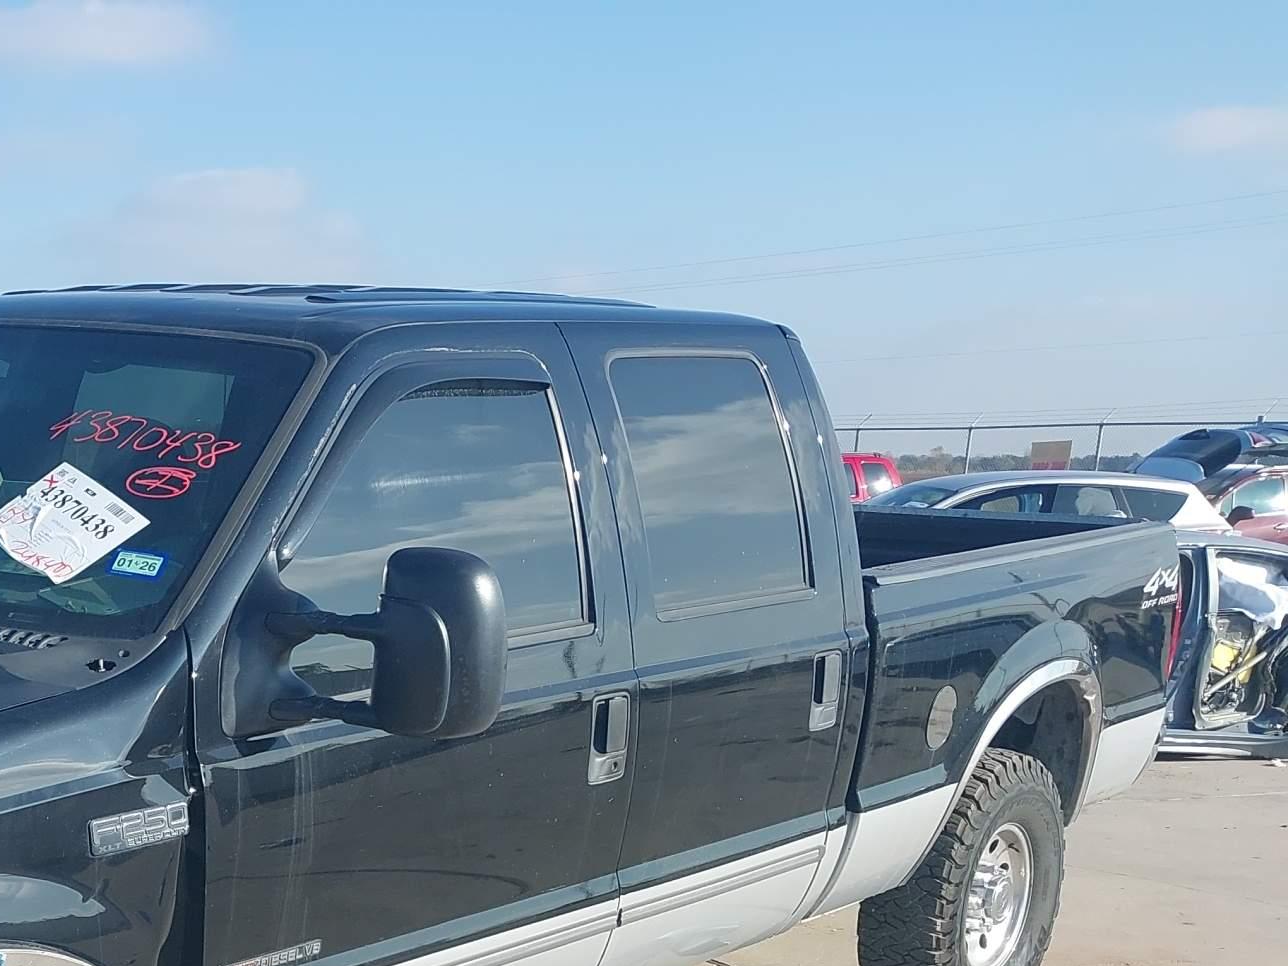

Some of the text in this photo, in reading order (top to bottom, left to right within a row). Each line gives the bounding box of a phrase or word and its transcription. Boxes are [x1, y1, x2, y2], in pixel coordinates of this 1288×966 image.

[49, 409, 242, 468] 43870438
[40, 485, 115, 540] 43870438
[116, 557, 158, 572] 01 26
[1141, 598, 1158, 609] OFF
[99, 842, 122, 853] XLT
